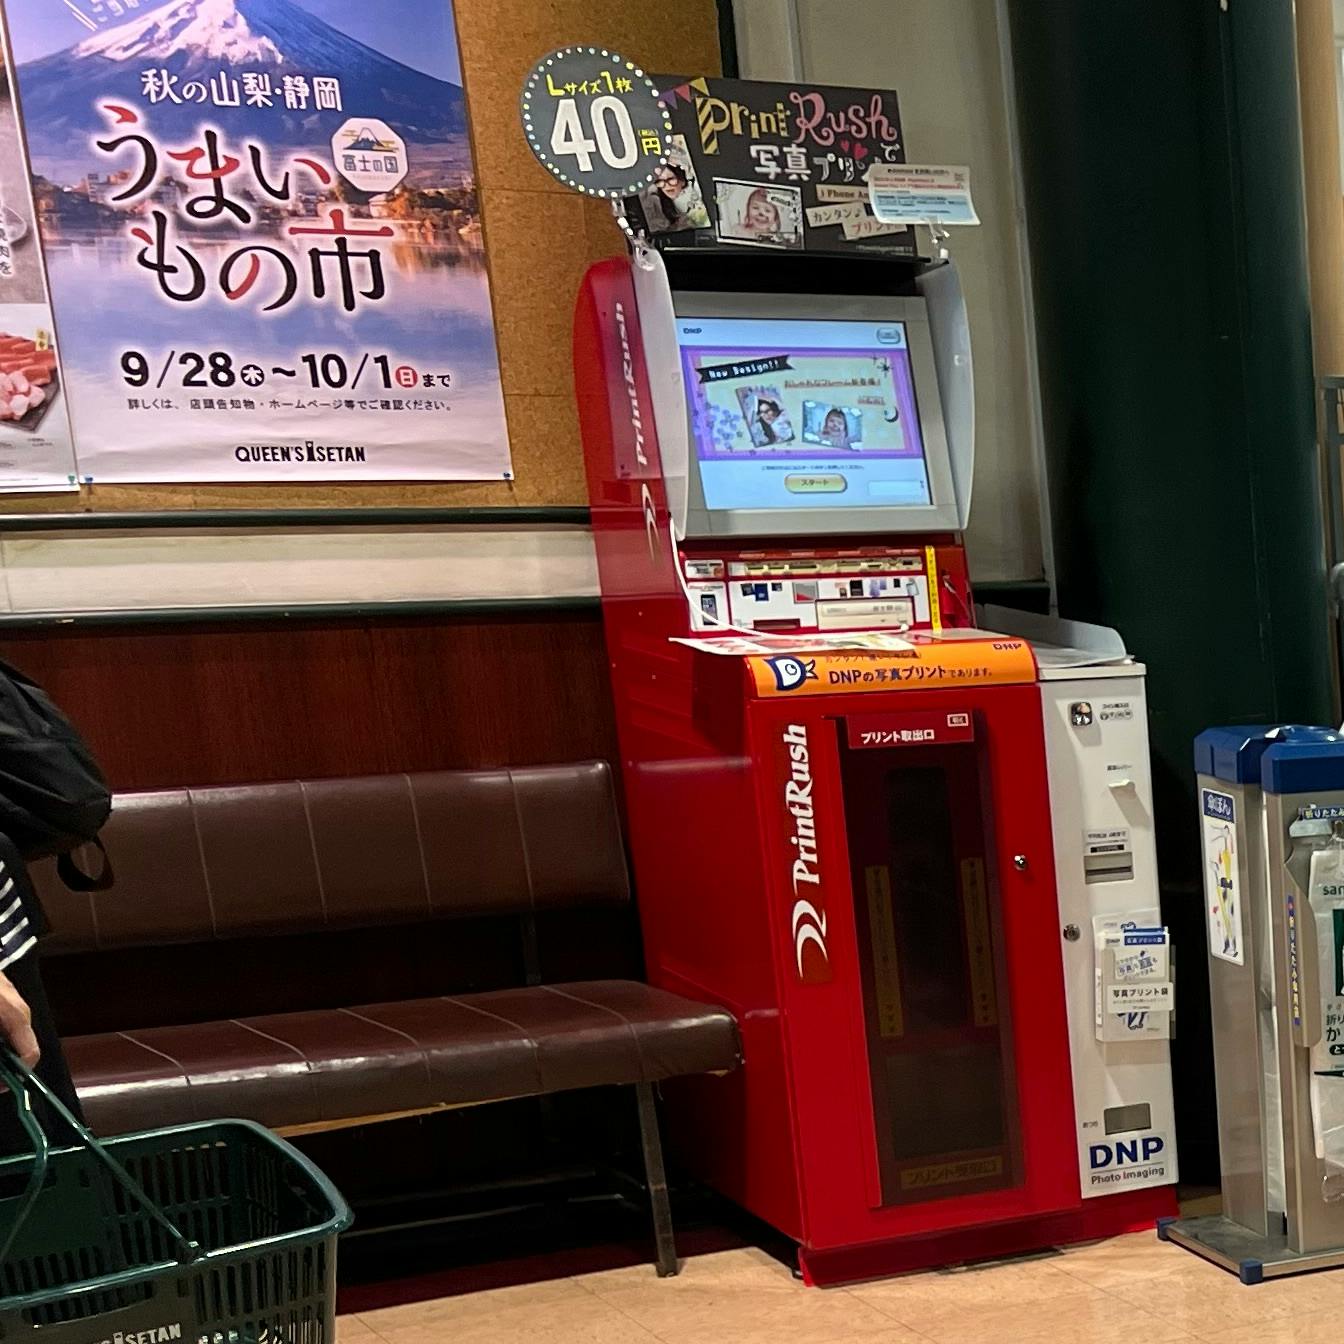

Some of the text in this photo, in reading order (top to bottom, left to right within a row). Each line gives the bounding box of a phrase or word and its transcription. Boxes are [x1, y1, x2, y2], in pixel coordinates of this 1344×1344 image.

[141, 68, 342, 111] 秋の山梨・静岡
[551, 96, 662, 171] 40 円
[696, 92, 897, 155] Print Rush
[96, 105, 332, 224] うまい
[131, 208, 394, 312] もの市
[861, 729, 935, 744] プリント取出口
[783, 723, 820, 896] PrintRush
[1089, 1136, 1164, 1169] DNP
[1091, 1166, 1165, 1184] Photo Imaging
